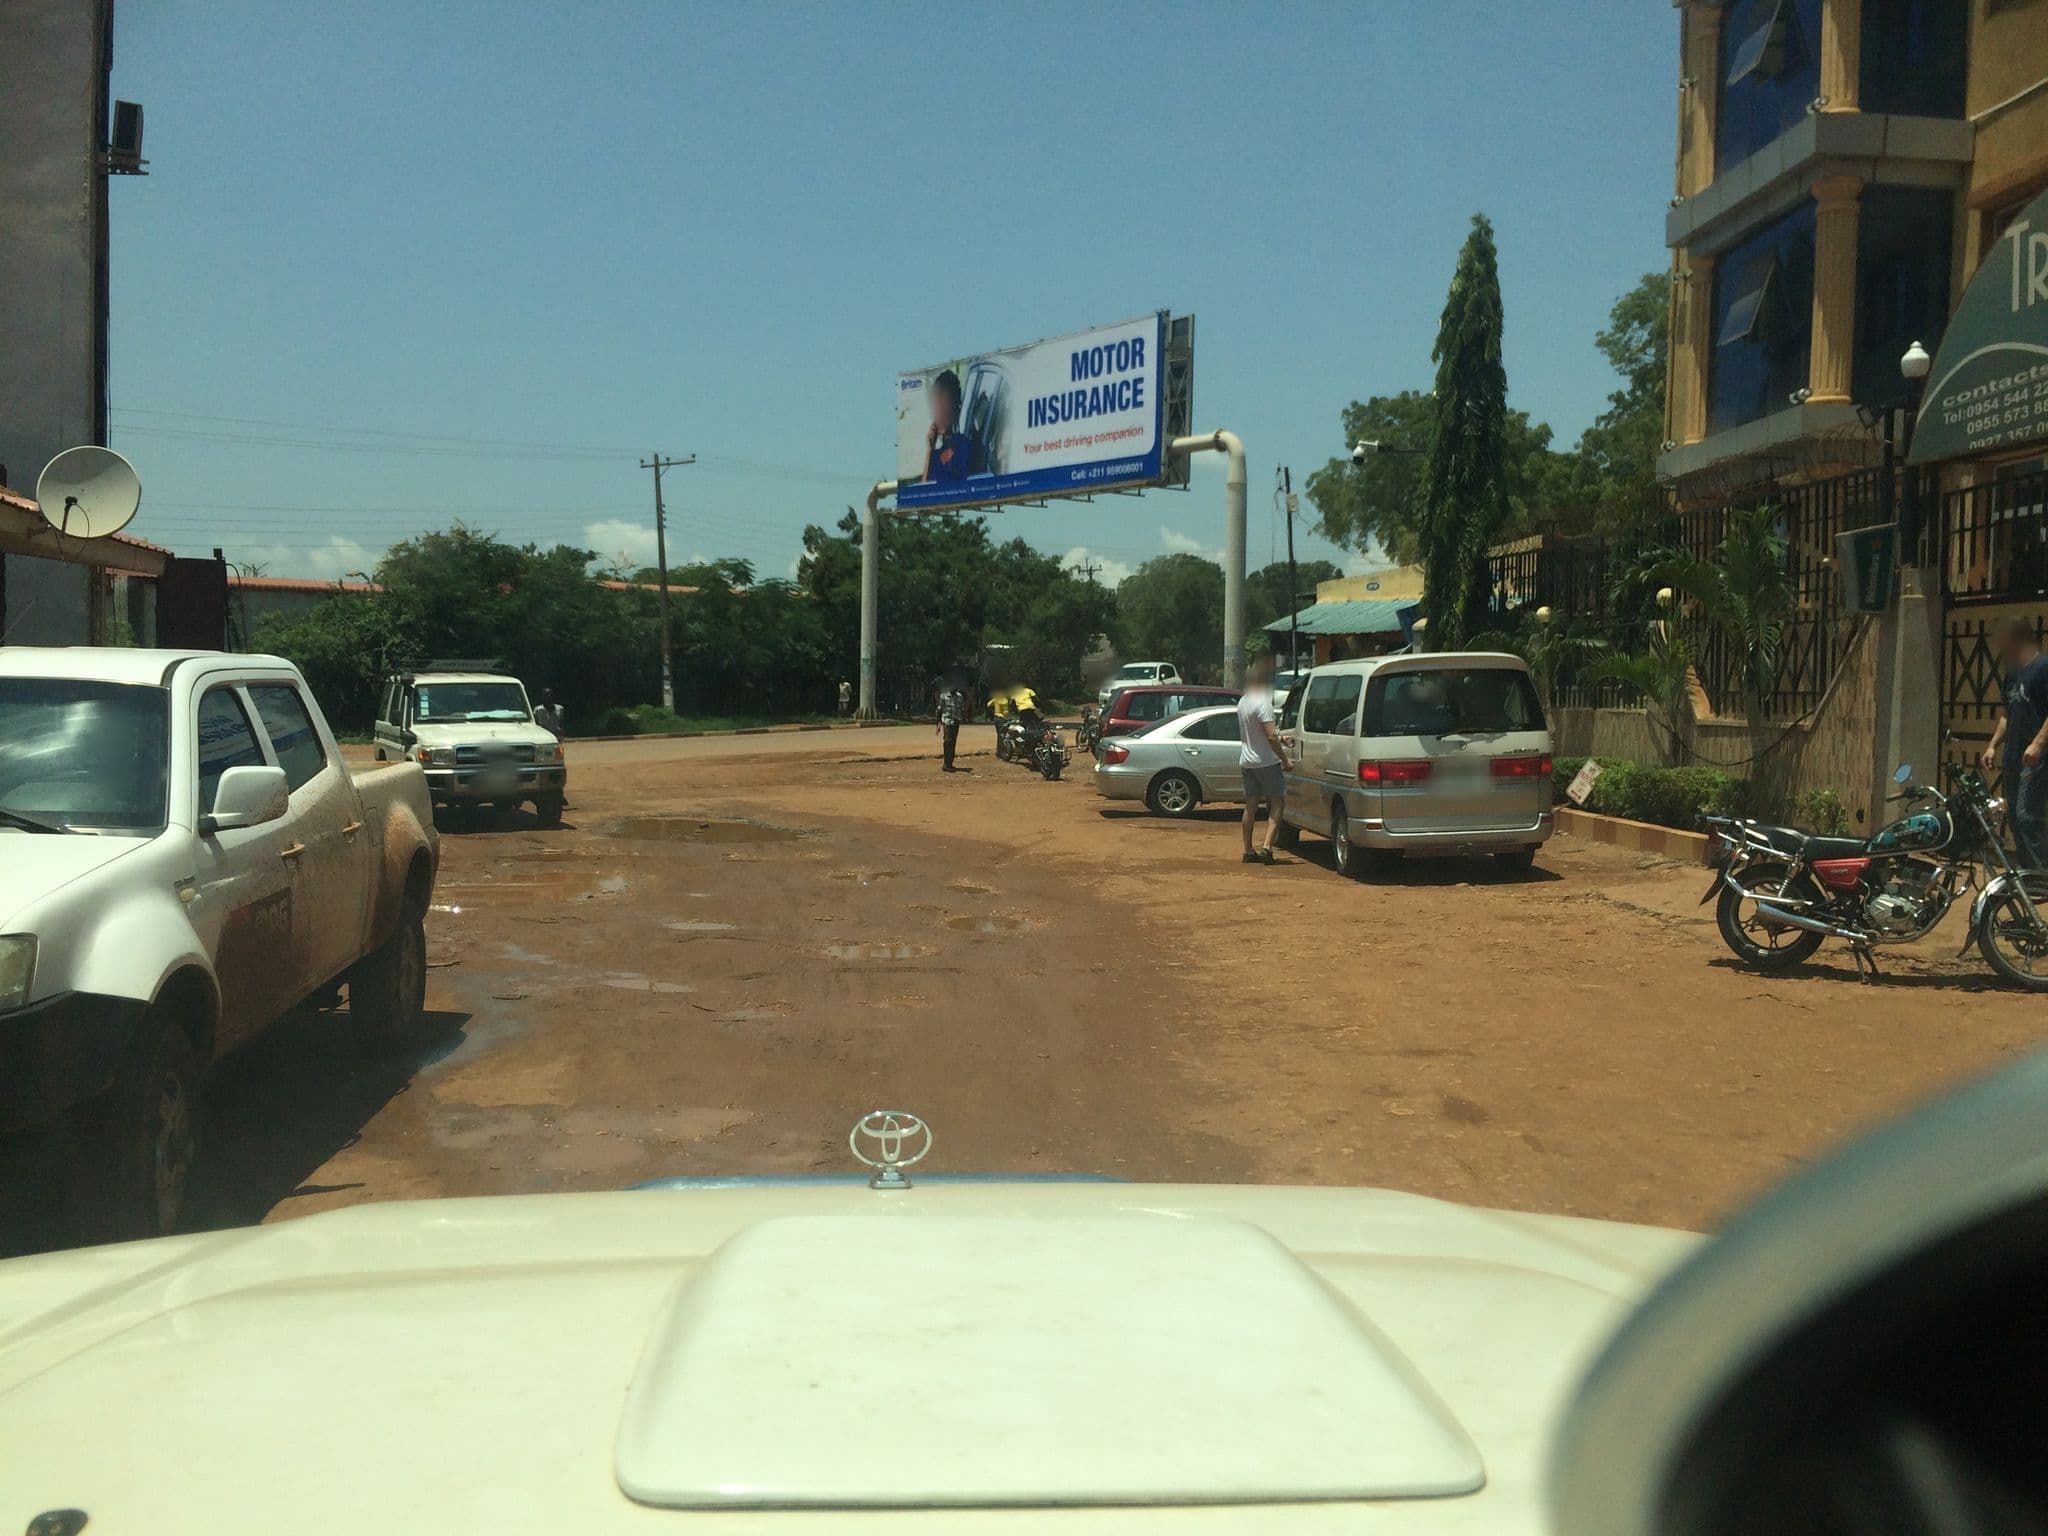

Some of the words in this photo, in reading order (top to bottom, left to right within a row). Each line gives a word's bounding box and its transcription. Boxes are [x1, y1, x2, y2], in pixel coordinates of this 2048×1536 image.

[1071, 337, 1145, 382] MOTOR
[1027, 377, 1145, 429] INSURANCE
[2003, 387, 2028, 406] 544
[1967, 413, 2000, 434] 0955
[2004, 404, 2029, 423] 573
[1023, 443, 1042, 455] Your
[1044, 439, 1062, 452] best
[1064, 434, 1092, 449] driving
[1094, 425, 1144, 444] companion
